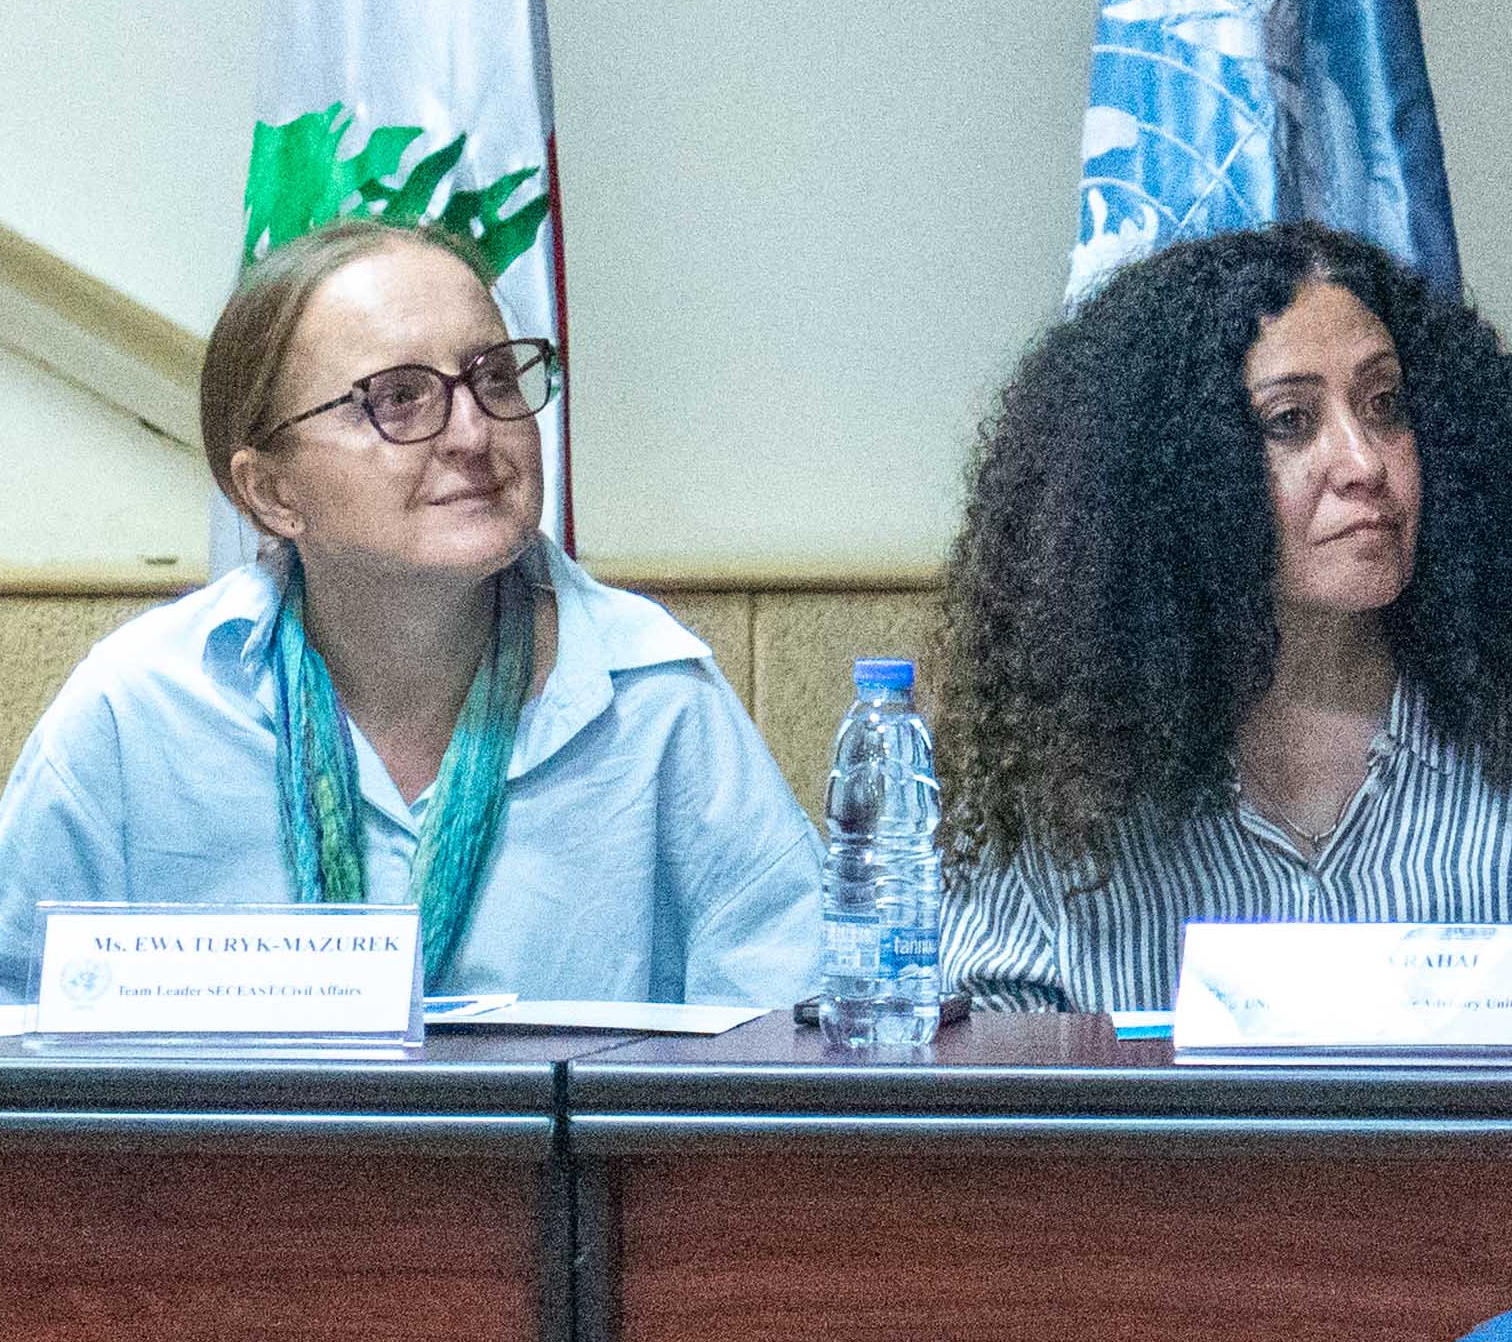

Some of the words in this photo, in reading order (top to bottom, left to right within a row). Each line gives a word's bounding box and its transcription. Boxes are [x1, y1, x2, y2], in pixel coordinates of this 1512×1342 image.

[94, 936, 128, 953] Ms.
[135, 936, 185, 953] EWA
[193, 935, 400, 953] TURYK-MAZUREK
[118, 984, 153, 997] Team
[157, 984, 202, 997] Leader
[319, 984, 363, 997] Affairs
